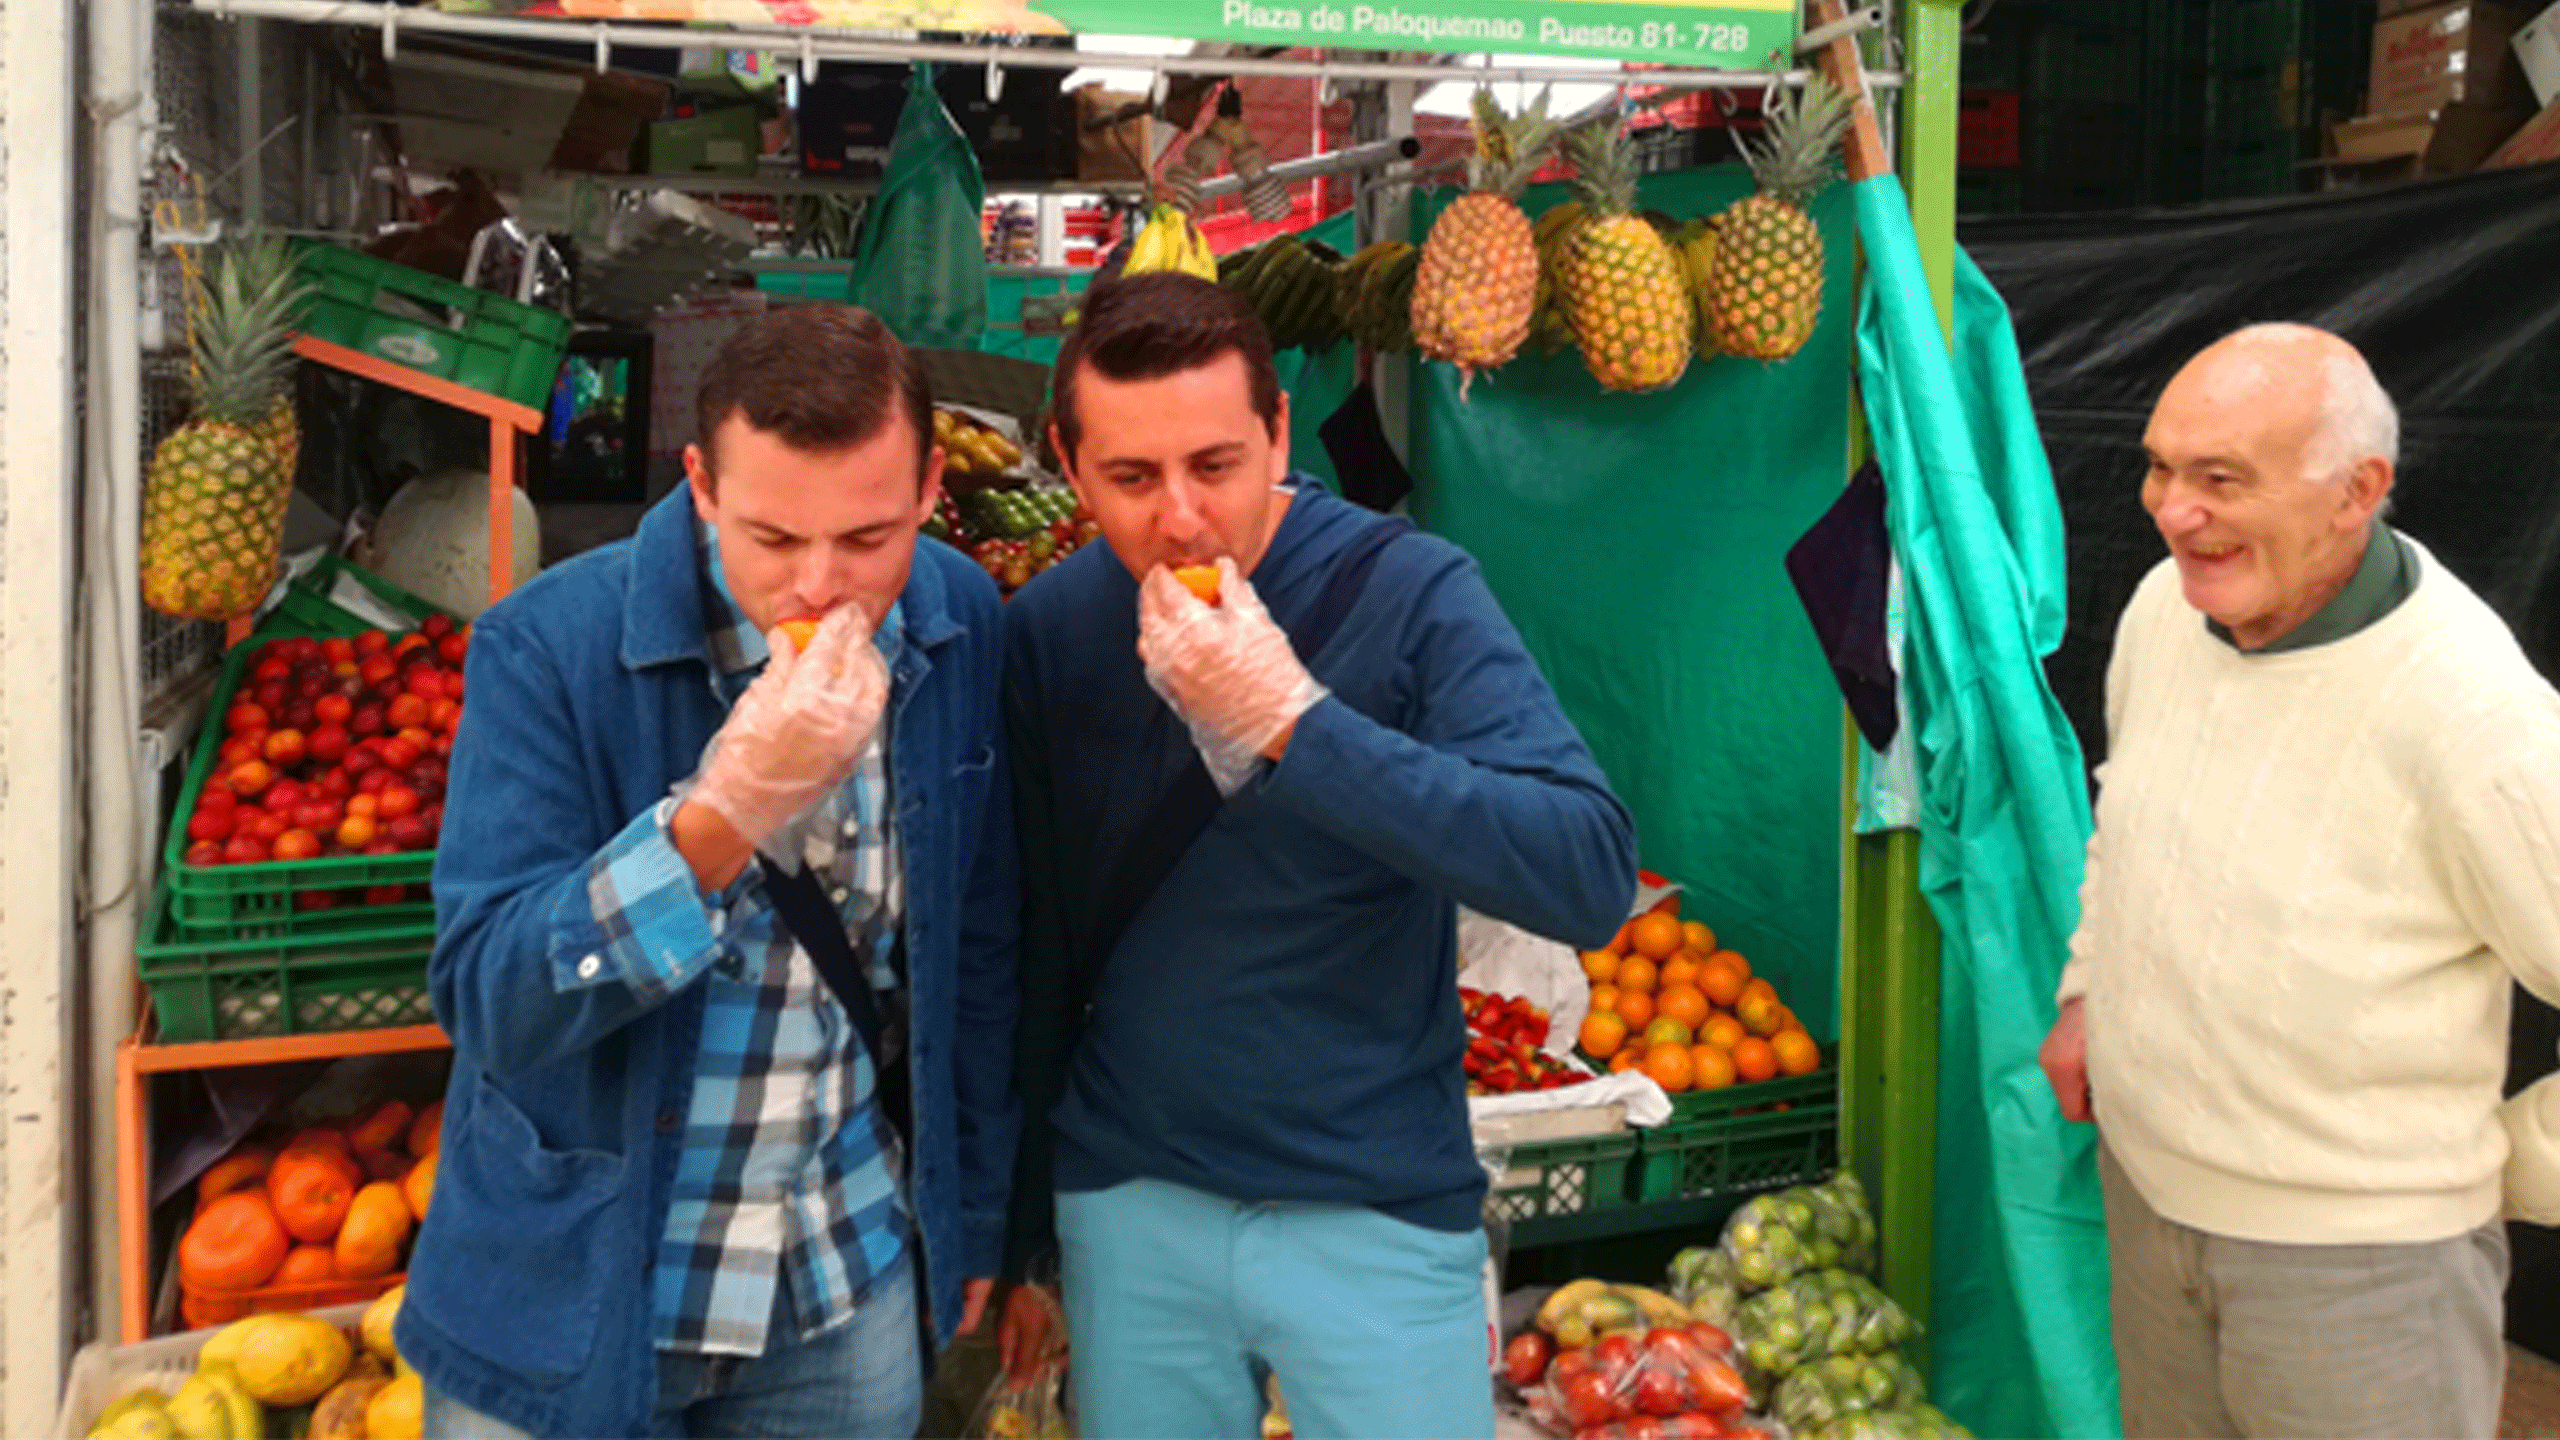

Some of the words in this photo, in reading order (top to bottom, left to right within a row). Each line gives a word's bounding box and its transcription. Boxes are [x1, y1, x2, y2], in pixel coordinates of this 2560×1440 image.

[1223, 0, 1302, 29] Plaza
[1309, 4, 1345, 31] de
[1353, 5, 1525, 42] Paloquemao
[1540, 16, 1634, 47] Puesto
